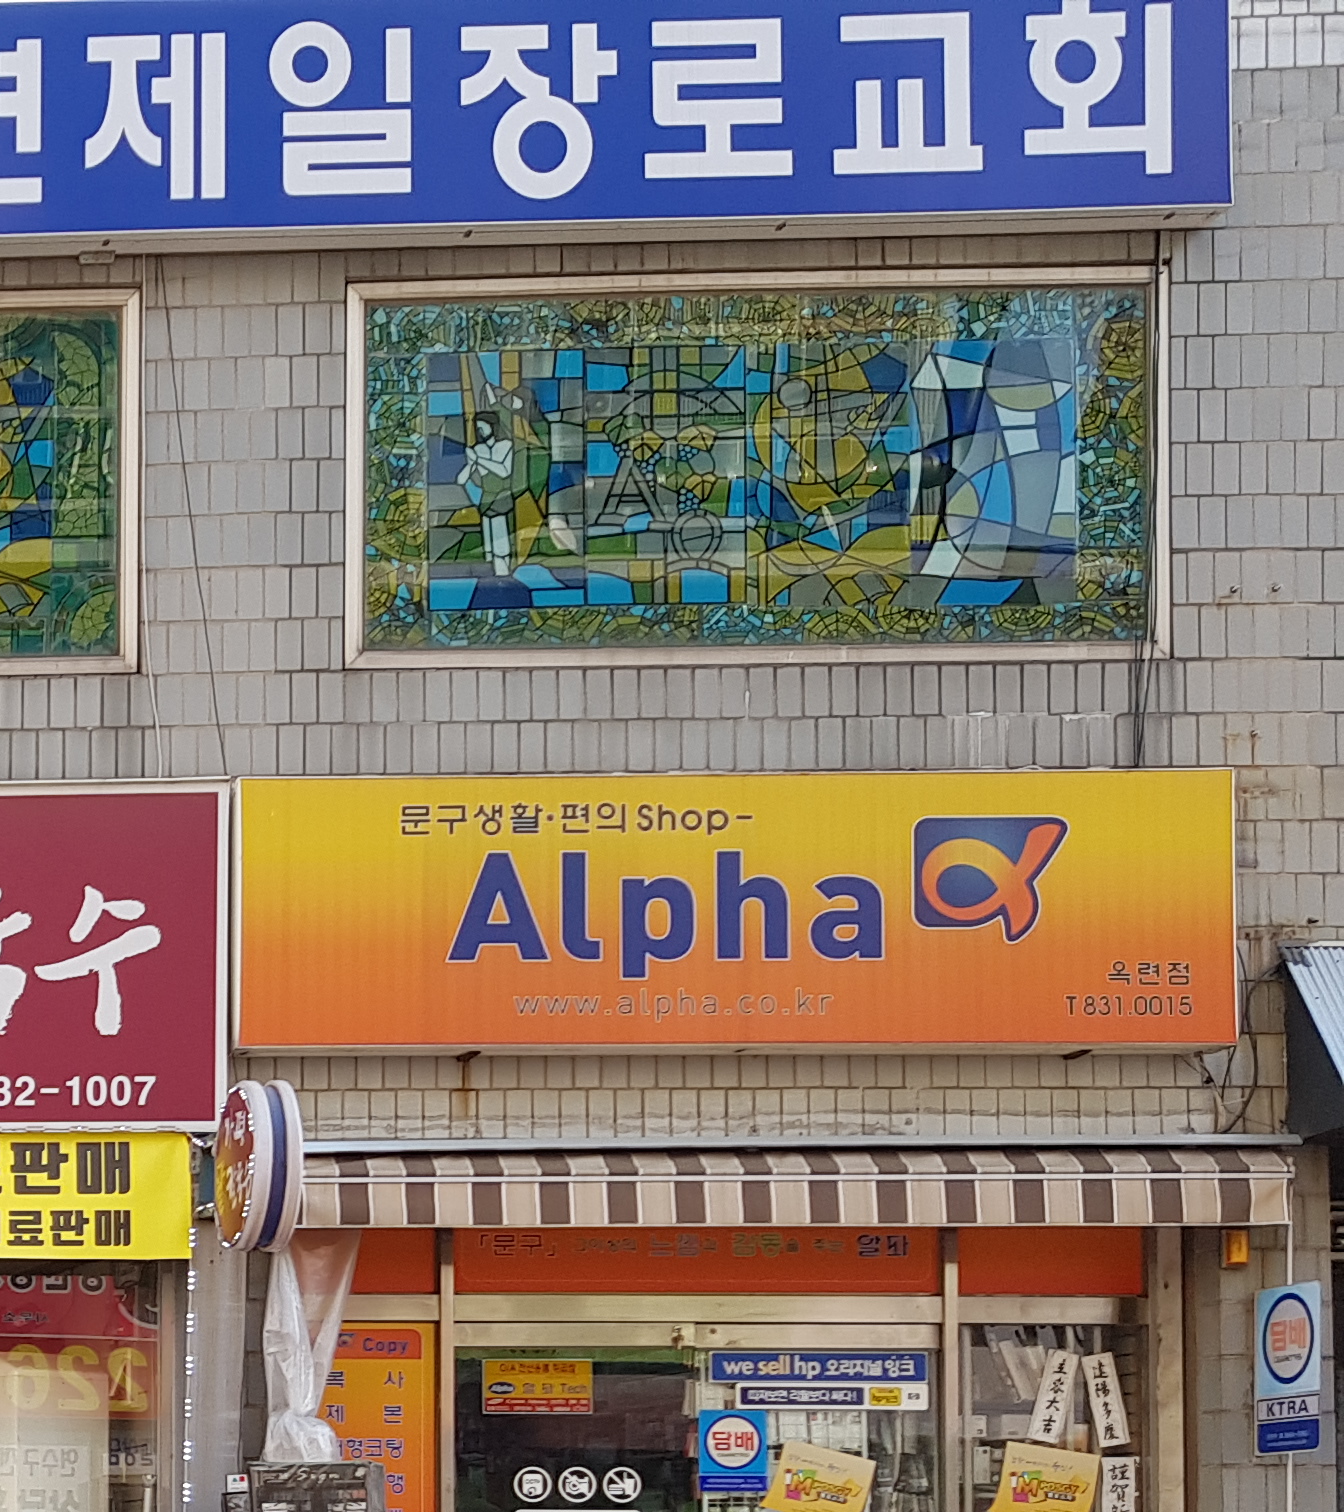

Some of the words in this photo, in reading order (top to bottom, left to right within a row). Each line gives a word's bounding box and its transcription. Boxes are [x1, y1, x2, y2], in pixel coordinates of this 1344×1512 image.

[445, 847, 886, 982] Alpha
[1106, 959, 1193, 987] 옥련점
[512, 989, 835, 1018] www.alpha.co.kr
[363, 1337, 410, 1356] Copy
[1270, 1317, 1307, 1352] 담배
[723, 1360, 754, 1376] we
[757, 1355, 790, 1376] sell
[794, 1355, 821, 1379] hp
[824, 1359, 883, 1377] 오리지널
[884, 1356, 915, 1378] 잉크
[1266, 1399, 1310, 1418] KTRA
[712, 1431, 755, 1452] 담배
